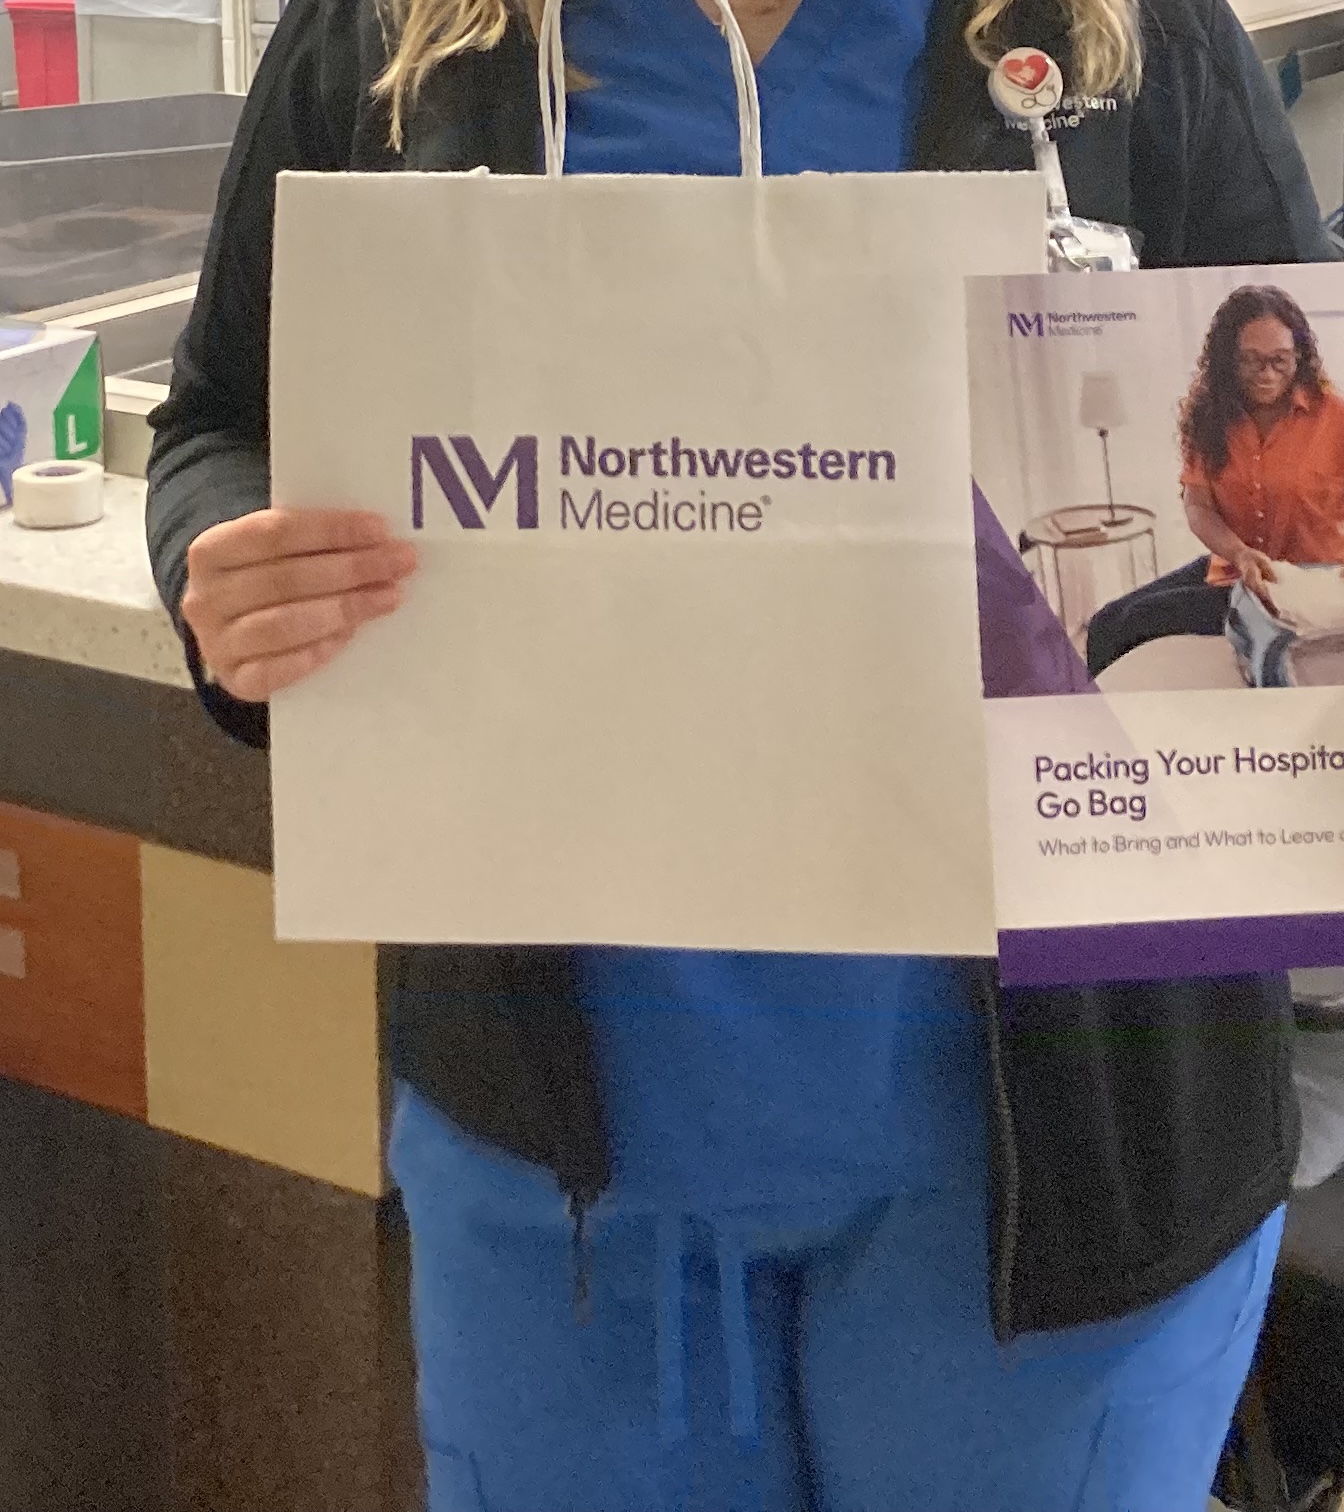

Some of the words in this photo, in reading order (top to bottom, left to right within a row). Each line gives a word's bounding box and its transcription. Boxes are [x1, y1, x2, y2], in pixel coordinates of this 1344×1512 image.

[1048, 311, 1136, 323] Northwestern
[67, 414, 88, 455] L
[560, 435, 897, 482] Northwestern
[1035, 750, 1150, 785] Packing
[1156, 748, 1226, 776] Your
[1036, 792, 1081, 819] Go
[1089, 789, 1147, 822] Bag
[1038, 837, 1087, 856] What
[1092, 839, 1110, 854] to
[1113, 835, 1161, 856] Bring
[1166, 832, 1200, 849] and
[1204, 828, 1253, 848] What
[1258, 830, 1276, 846] to
[1280, 827, 1334, 845] Leave
